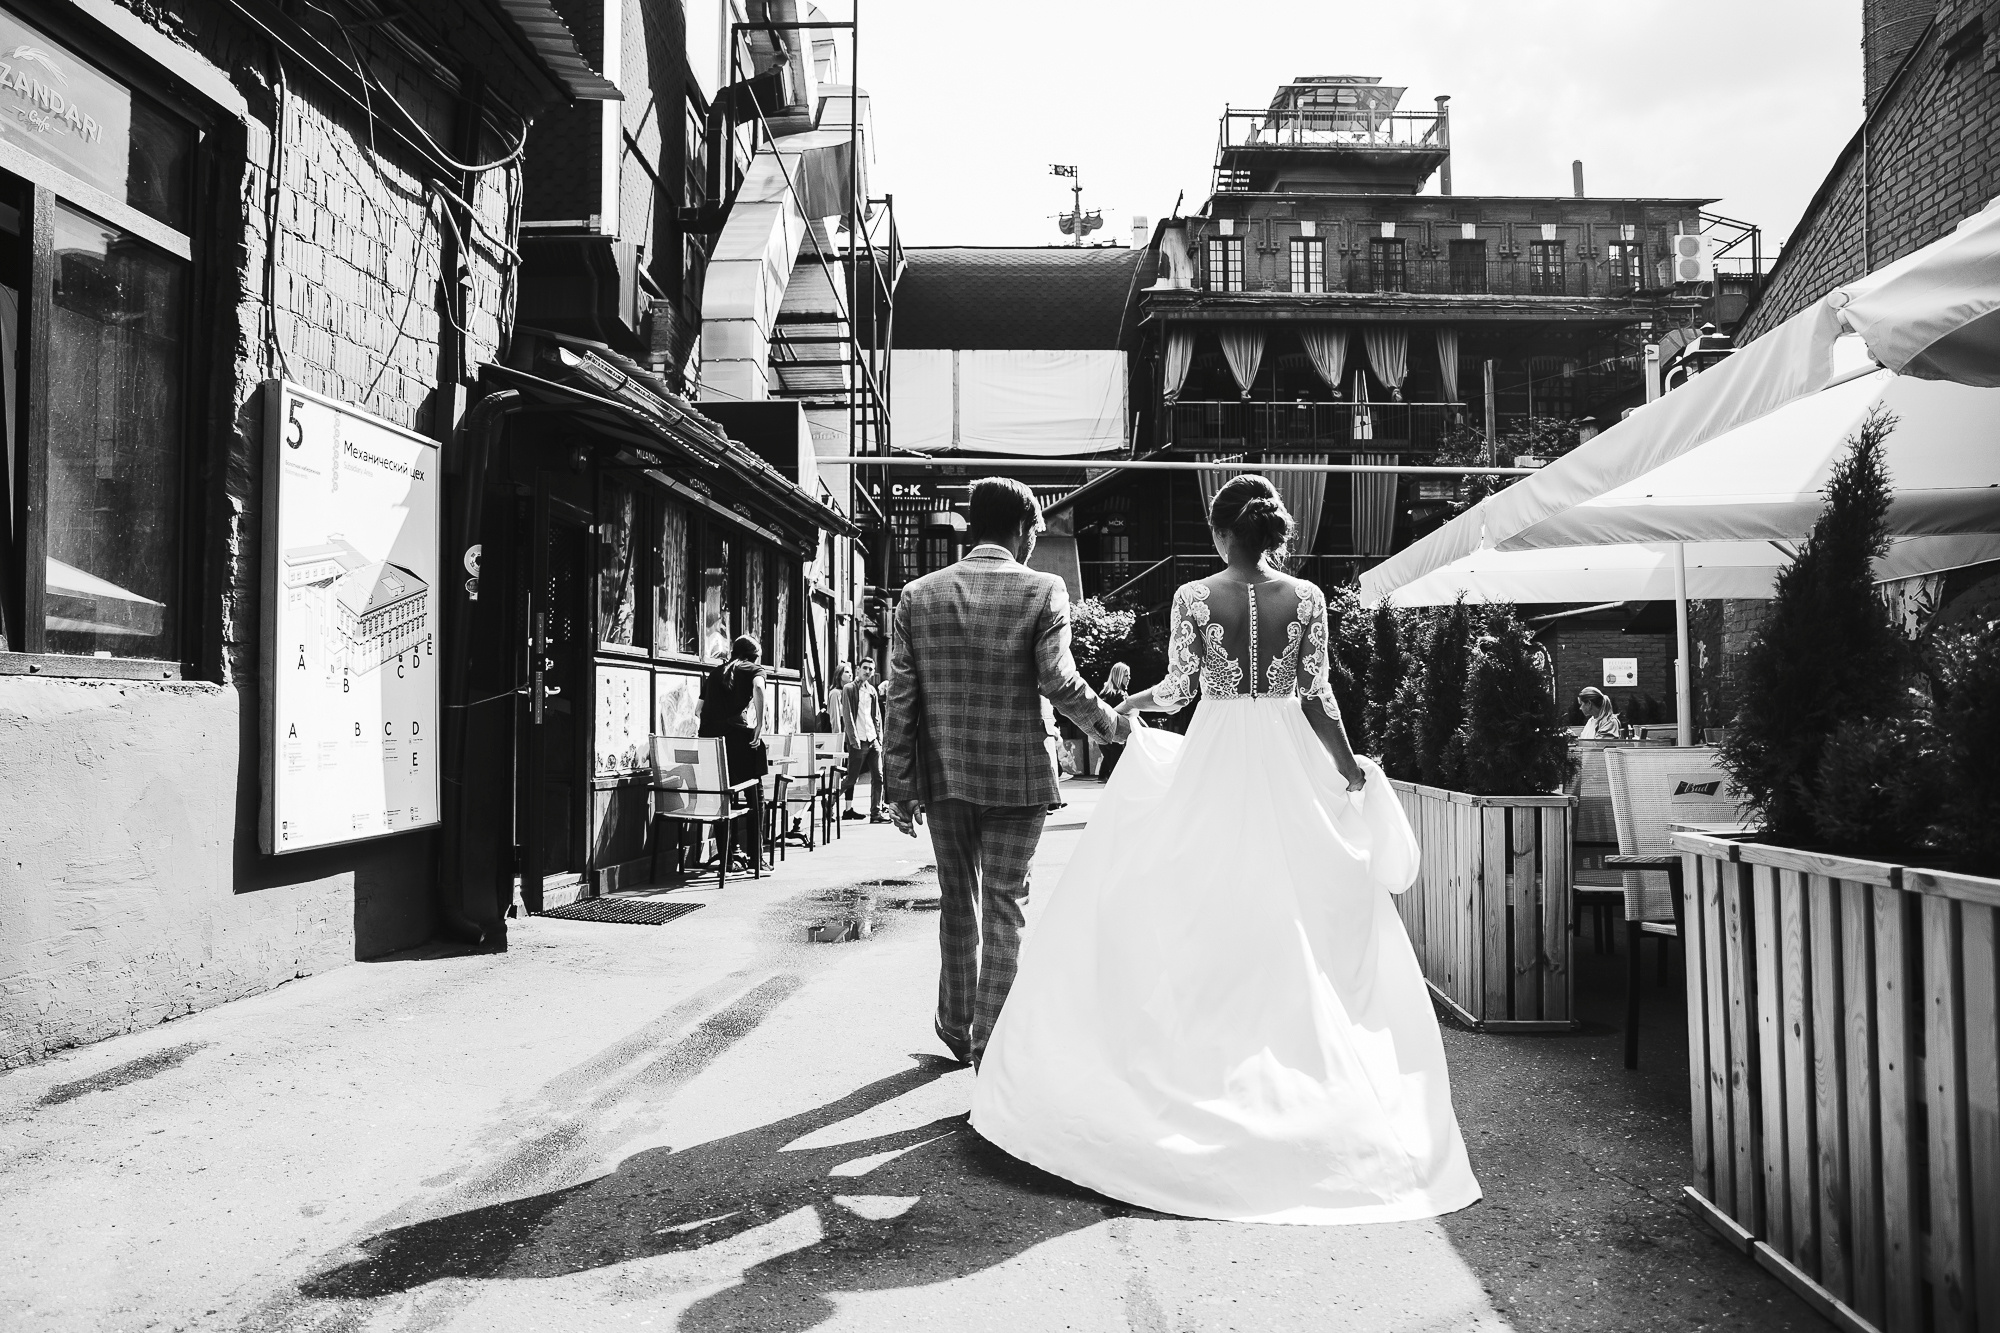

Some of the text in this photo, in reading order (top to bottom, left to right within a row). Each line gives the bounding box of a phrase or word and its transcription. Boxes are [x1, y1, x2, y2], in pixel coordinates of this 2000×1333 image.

[0, 61, 103, 145] ZANDARI
[286, 398, 305, 450] 5
[344, 440, 425, 482] Механический цех
[427, 641, 433, 656] E
[298, 654, 306, 670] A
[413, 654, 420, 669] D
[397, 664, 405, 679] C
[343, 677, 350, 693] B
[288, 720, 420, 739] A B C D
[412, 752, 419, 767] E
